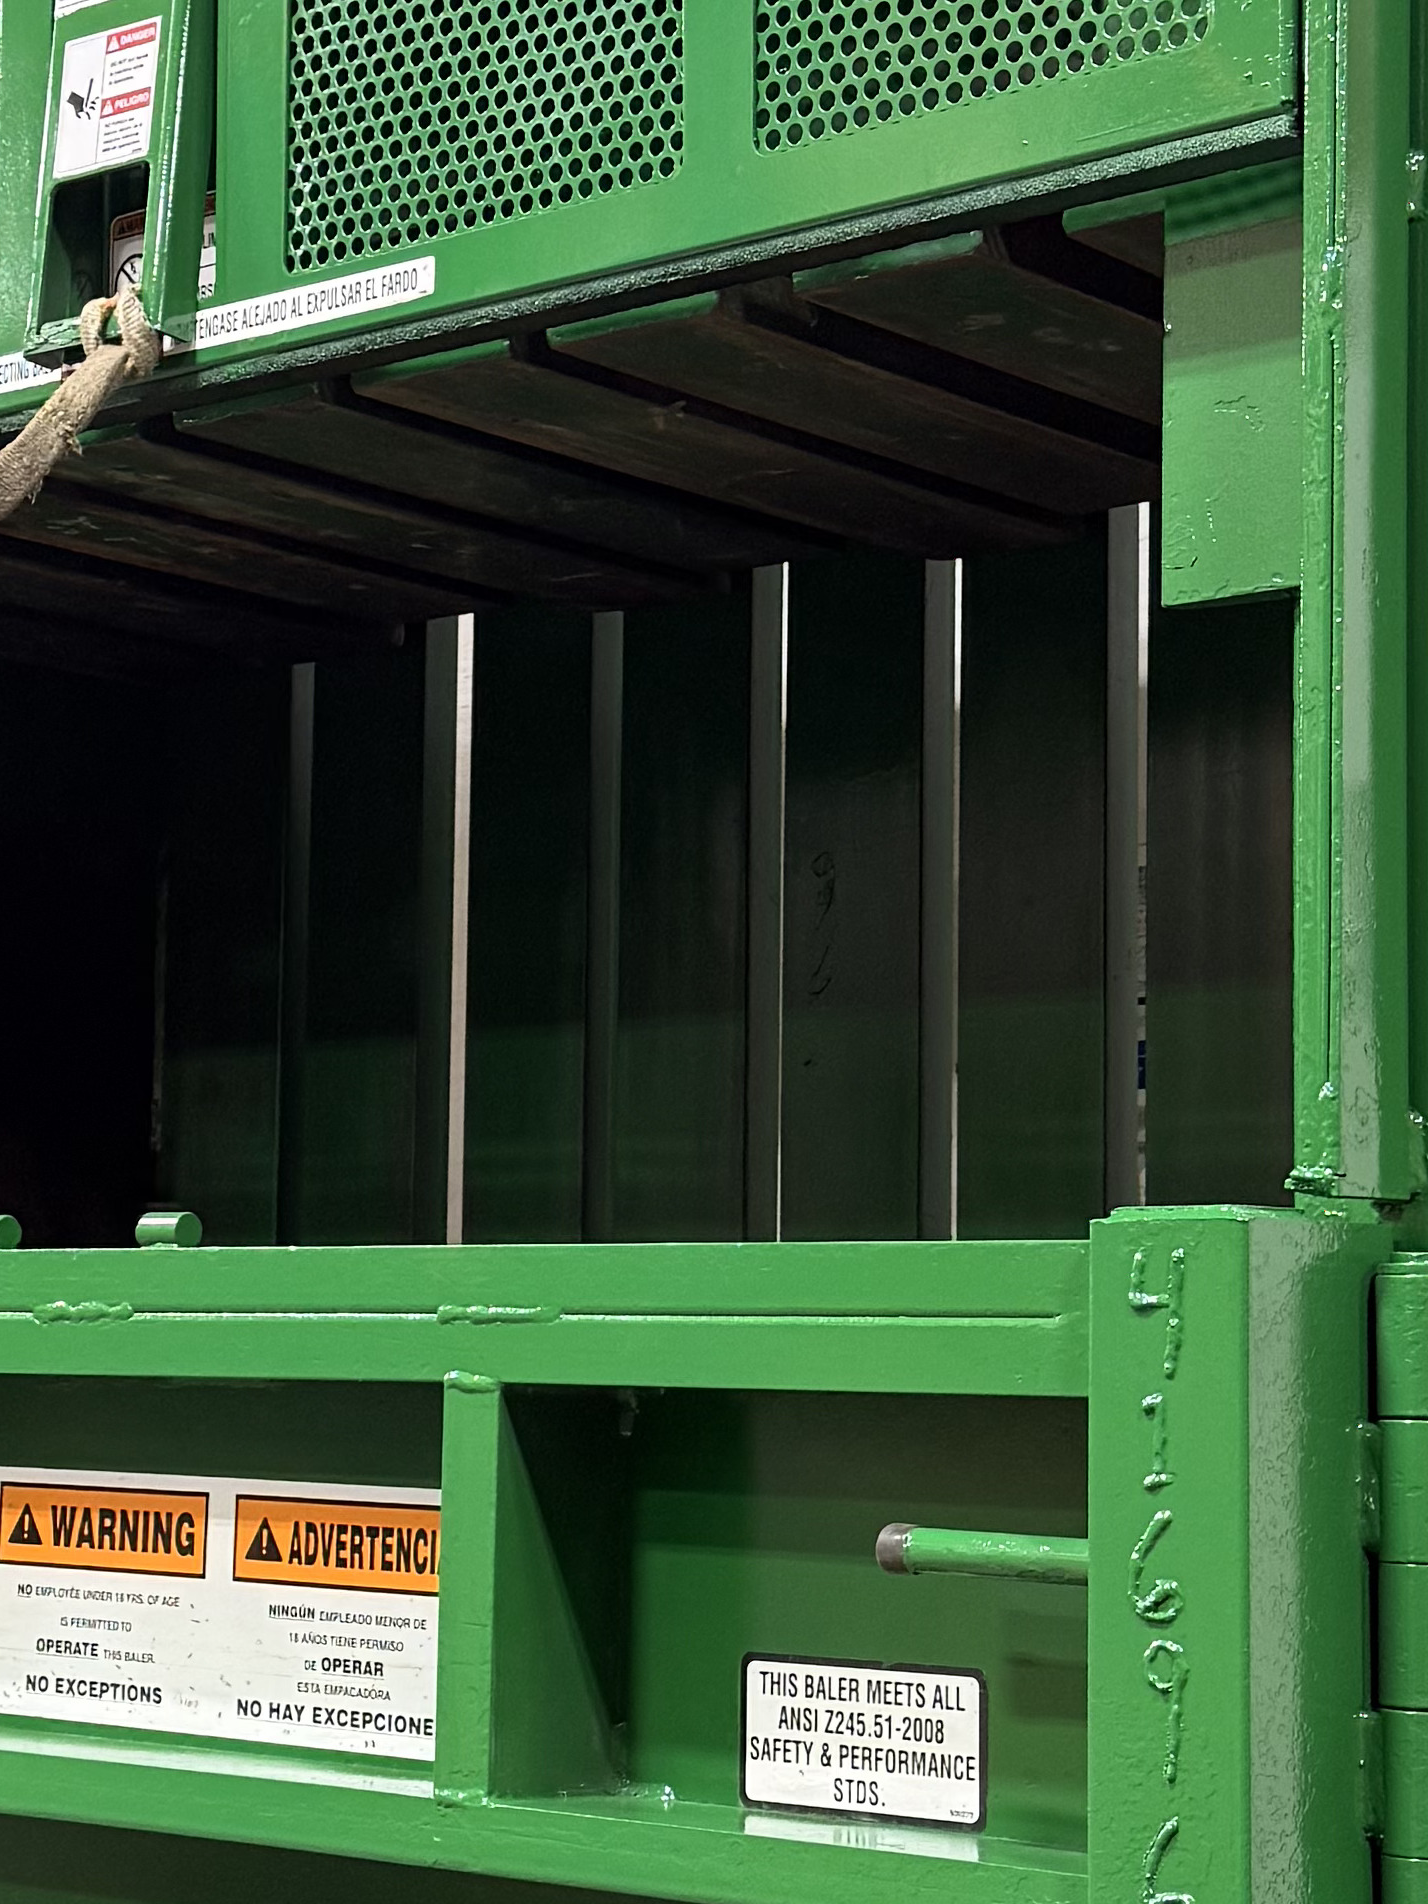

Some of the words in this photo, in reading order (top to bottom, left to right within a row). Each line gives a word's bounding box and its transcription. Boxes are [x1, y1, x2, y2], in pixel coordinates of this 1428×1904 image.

[114, 91, 151, 111] PELIGRO
[241, 297, 288, 330] ALEJADO
[290, 296, 304, 318] AL
[307, 285, 362, 316] EXPULSAR
[365, 277, 378, 301] EL
[380, 267, 419, 297] FARDO
[50, 1503, 196, 1558] WARNING
[287, 1519, 440, 1576] ADVERTENCI
[17, 1583, 33, 1597] NO
[35, 1585, 80, 1601] EMPLOYEE
[83, 1589, 113, 1603] UNDER
[147, 1594, 161, 1606] OF
[162, 1596, 181, 1608] AGE
[60, 1616, 69, 1628] IS
[70, 1617, 120, 1632] PERMITTED
[120, 1621, 133, 1633] TO
[268, 1603, 316, 1620] NINGÚN
[319, 1610, 373, 1626] EMPLEADO
[375, 1614, 412, 1630] MENOR
[413, 1617, 428, 1631] DE
[35, 1637, 100, 1658] OPERATE
[103, 1648, 122, 1662] THIS
[289, 1631, 300, 1644] 18
[301, 1631, 328, 1646] AÑOS
[330, 1636, 358, 1649] TIENE
[359, 1638, 405, 1653] PERMISO
[304, 1659, 318, 1672] DE
[320, 1656, 385, 1677] OPERAR
[25, 1673, 50, 1693] NO
[54, 1676, 163, 1706] EXCEPTIONS
[296, 1682, 322, 1695] ESTA
[758, 1670, 799, 1699] THIS
[803, 1674, 861, 1704] BALER
[866, 1679, 927, 1709] MEETS
[932, 1684, 967, 1712] ALL
[236, 1698, 263, 1719] NO
[268, 1702, 306, 1723] HAY
[777, 1705, 819, 1733] ANSI
[823, 1709, 946, 1745] Z245.51-2008
[749, 1735, 814, 1766] SAFETY
[819, 1741, 833, 1768] &
[838, 1744, 977, 1782] PERFORMANCE
[833, 1777, 887, 1807] STDS.
